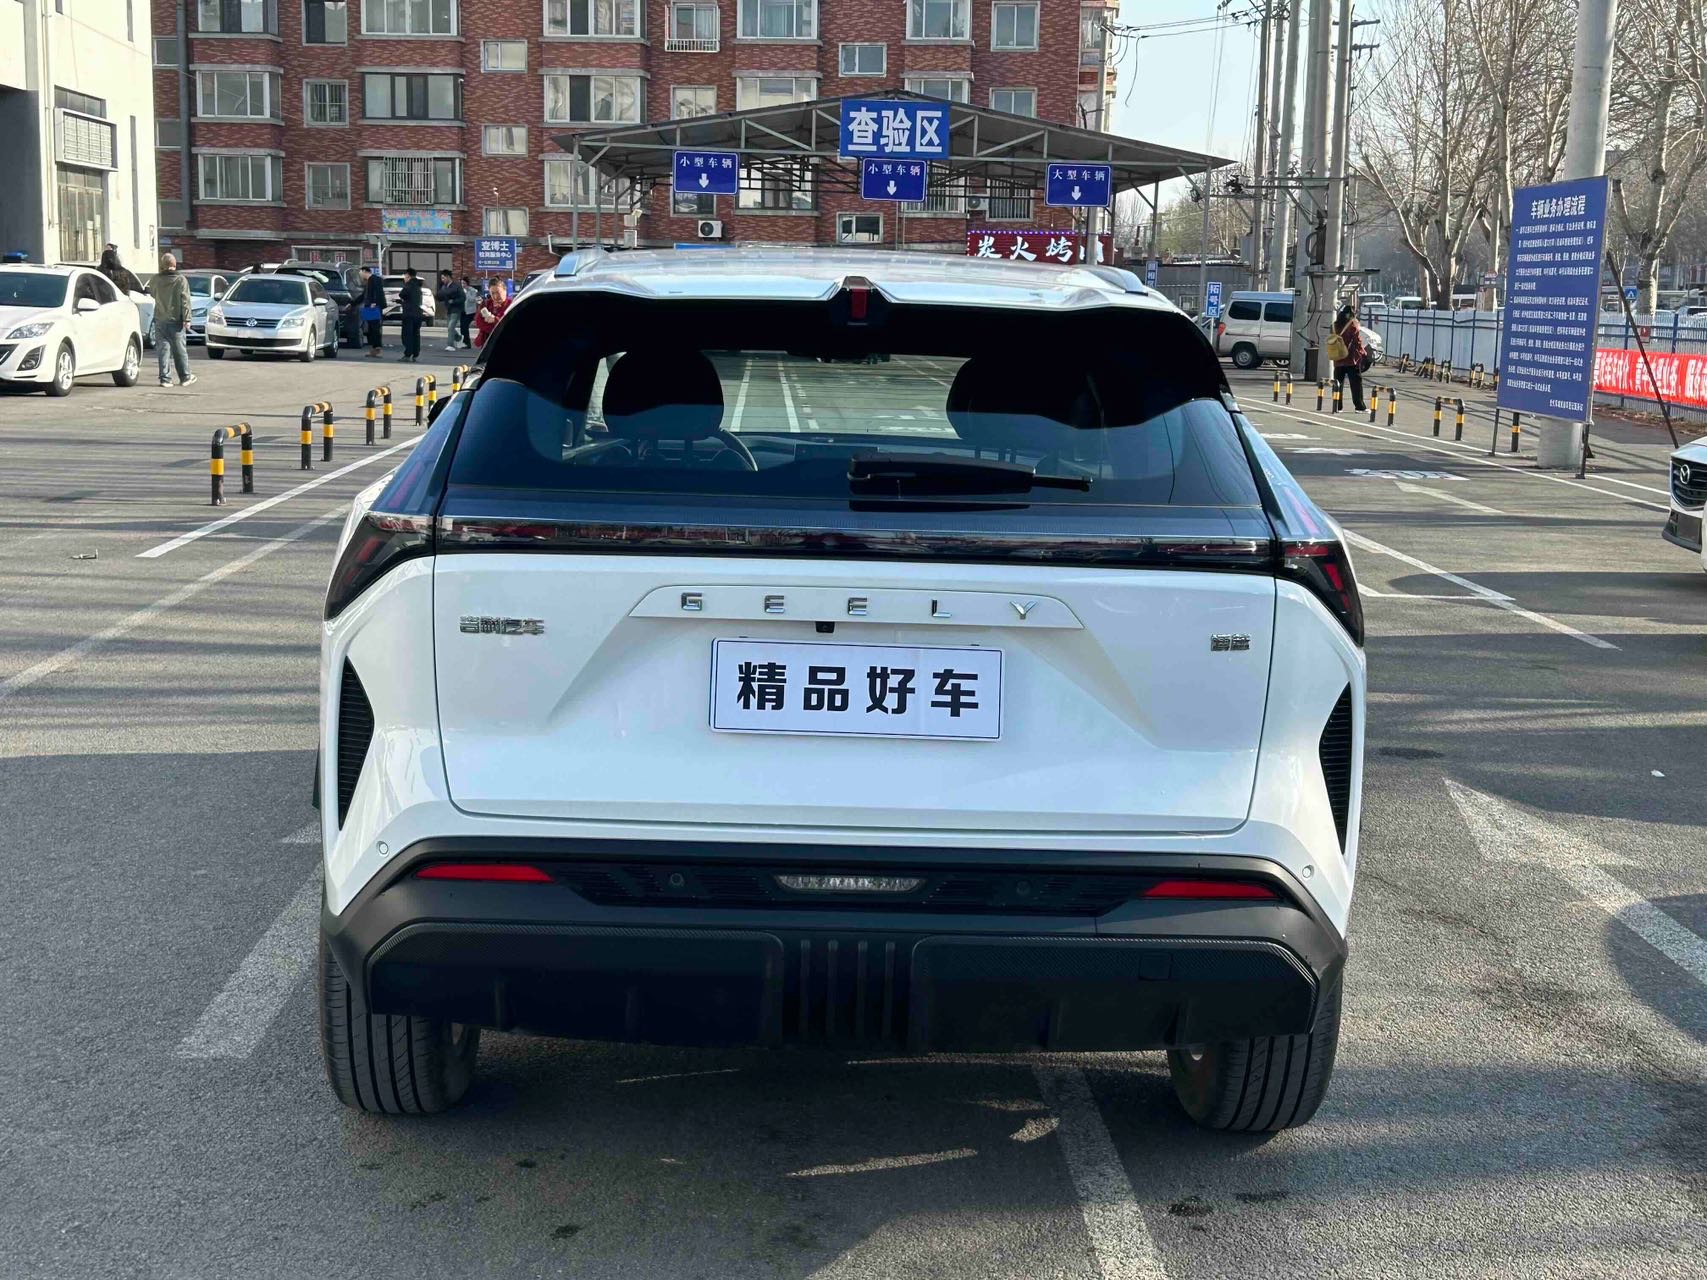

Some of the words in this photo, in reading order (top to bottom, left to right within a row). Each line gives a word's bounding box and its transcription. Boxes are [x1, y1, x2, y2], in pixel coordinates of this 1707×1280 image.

[847, 106, 943, 153] 查验区
[679, 156, 733, 169] 小型车辆
[867, 163, 921, 176] 小型车辆
[1052, 169, 1106, 182] 大型车辆
[1530, 194, 1586, 219] 车辆业务办理流程
[681, 592, 1036, 621] GEELY
[736, 661, 980, 718] 精品好车
